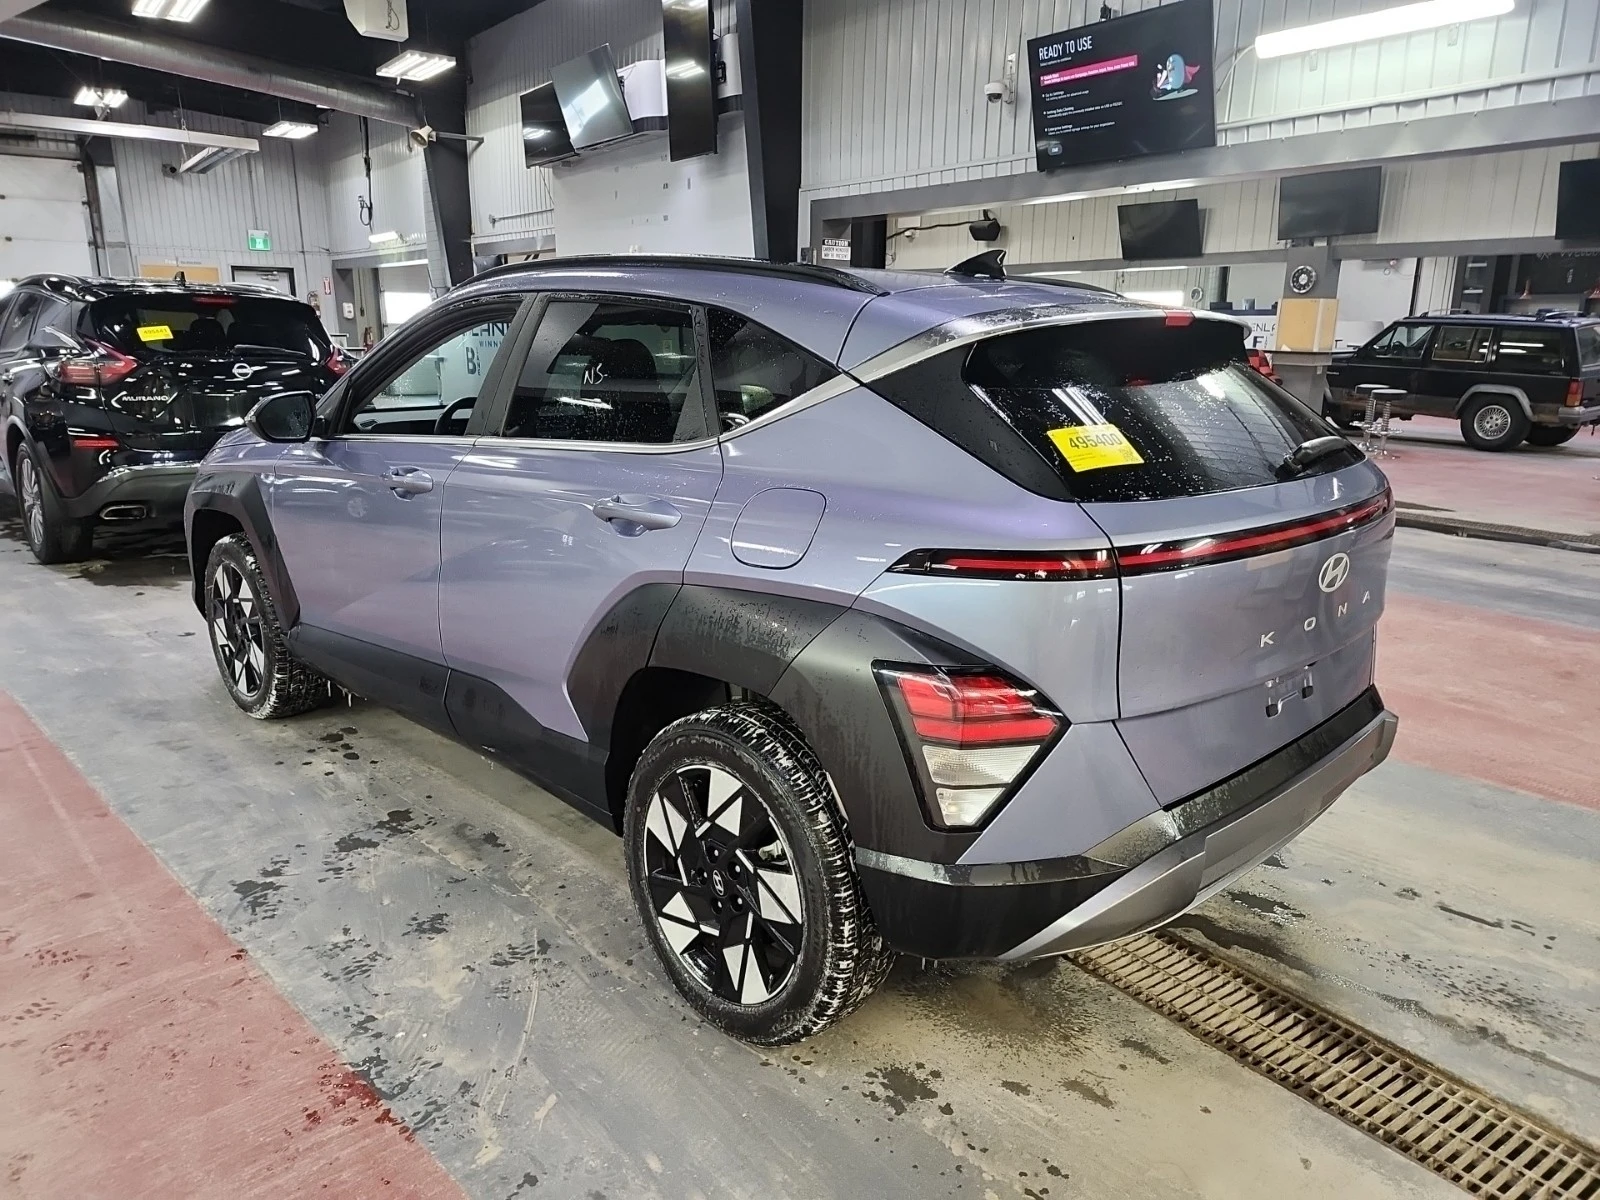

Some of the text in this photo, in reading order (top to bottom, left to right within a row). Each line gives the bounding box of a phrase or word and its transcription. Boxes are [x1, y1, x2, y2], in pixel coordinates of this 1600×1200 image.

[1039, 36, 1092, 60] READY TO USE
[466, 346, 477, 375] B
[1069, 433, 1123, 450] 495400
[1260, 590, 1371, 648] KONA
